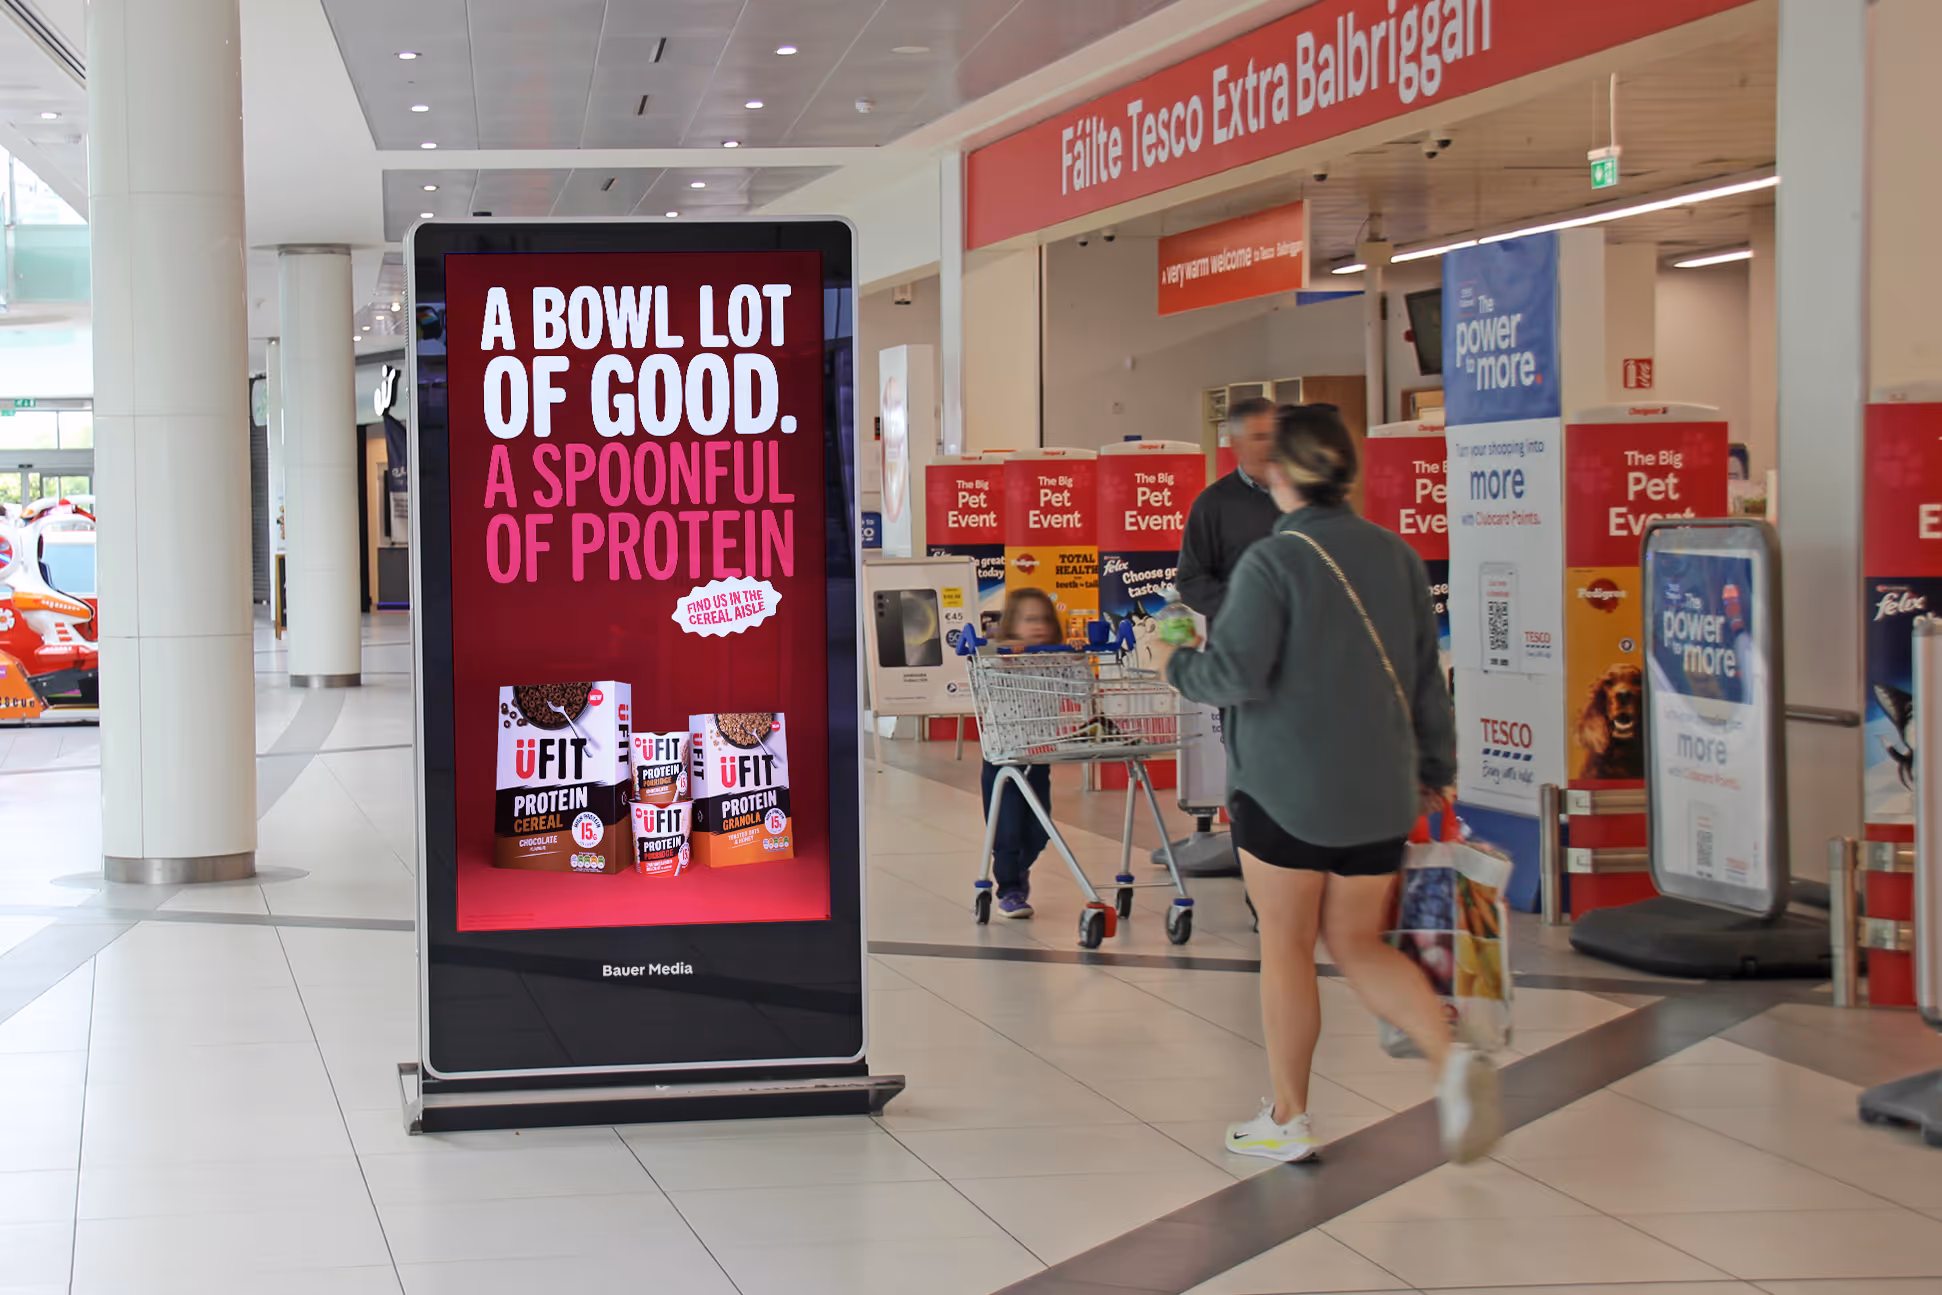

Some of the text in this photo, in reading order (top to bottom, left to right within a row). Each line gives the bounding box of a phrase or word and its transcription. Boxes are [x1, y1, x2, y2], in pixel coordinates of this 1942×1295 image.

[1061, 0, 1492, 196] Fáilte Tesco Extra Balbriggan
[1166, 261, 1185, 288] very
[1185, 256, 1210, 280] warm
[1210, 246, 1252, 274] welcome
[1477, 294, 1495, 314] The
[480, 283, 793, 351] A BOWL LOT
[1455, 312, 1522, 369] power
[1465, 356, 1475, 374] to
[483, 354, 570, 440] OF
[590, 351, 798, 438] GOOD.
[1412, 460, 1440, 474] The
[1624, 450, 1684, 469] The Big
[483, 439, 796, 509] A SPOONFUL
[1038, 475, 1074, 488] The Big
[1134, 472, 1175, 486] The Big
[1470, 468, 1525, 500] more
[956, 479, 990, 491] The Big
[1415, 478, 1448, 504] Pe
[1627, 472, 1680, 501] Pet
[957, 491, 988, 508] Pet
[1039, 488, 1072, 508] Pet
[1136, 487, 1173, 507] Pet
[947, 511, 998, 528] Event
[1028, 510, 1082, 529] Event
[1124, 510, 1184, 532] Event
[1400, 508, 1449, 534] Eve
[485, 509, 795, 584] OF PROTEIN
[1058, 553, 1096, 564] TOTAL
[978, 566, 1005, 580] today
[1055, 564, 1100, 575] HEALTH
[1122, 567, 1164, 585] Choose
[1055, 580, 1079, 589] teeth
[1128, 582, 1160, 598] taste
[687, 589, 765, 615] FIND US IN THE
[1684, 592, 1703, 609] The
[688, 600, 766, 625] CEREAL AISLE
[1524, 631, 1552, 644] TESCO
[1663, 610, 1725, 647] power
[1480, 717, 1533, 749] TESCO
[515, 738, 588, 780] ÜFIT
[642, 738, 680, 761] ÜFIT
[1677, 733, 1728, 765] more
[642, 763, 680, 780] PROTEIN
[720, 755, 774, 789] ÜFIT
[513, 786, 588, 818] PROTEIN
[721, 789, 778, 819] PROTEIN
[513, 813, 564, 834] CEREAL
[643, 809, 682, 833] ÜFIT
[722, 811, 762, 831] GRANOLA
[519, 835, 558, 848] CHOCOLATE
[643, 835, 682, 853] PROTEIN
[602, 961, 694, 977] Bauer Media
